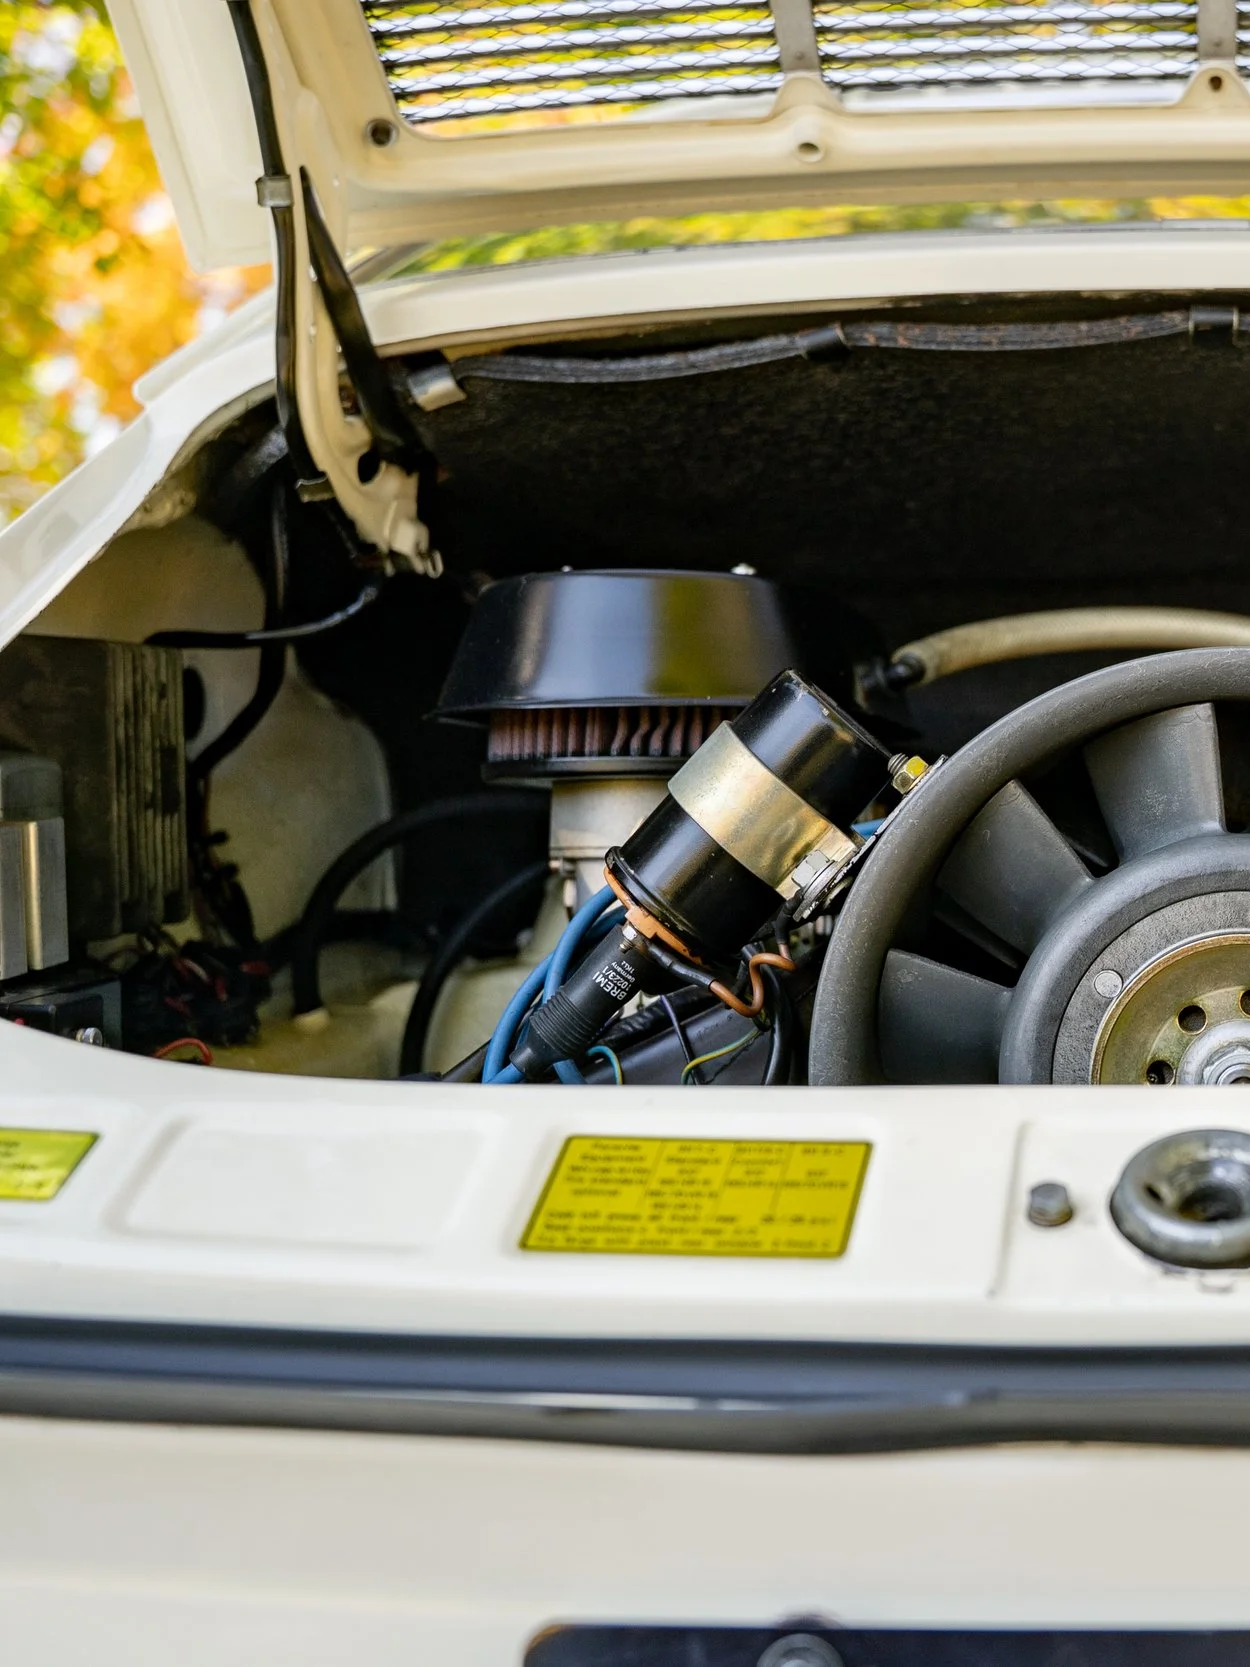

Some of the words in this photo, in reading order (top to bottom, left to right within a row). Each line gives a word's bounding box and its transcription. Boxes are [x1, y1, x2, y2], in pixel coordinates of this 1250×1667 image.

[602, 965, 632, 991] 10223/1
[611, 961, 635, 983] Germany
[592, 971, 627, 1000] BREMI
